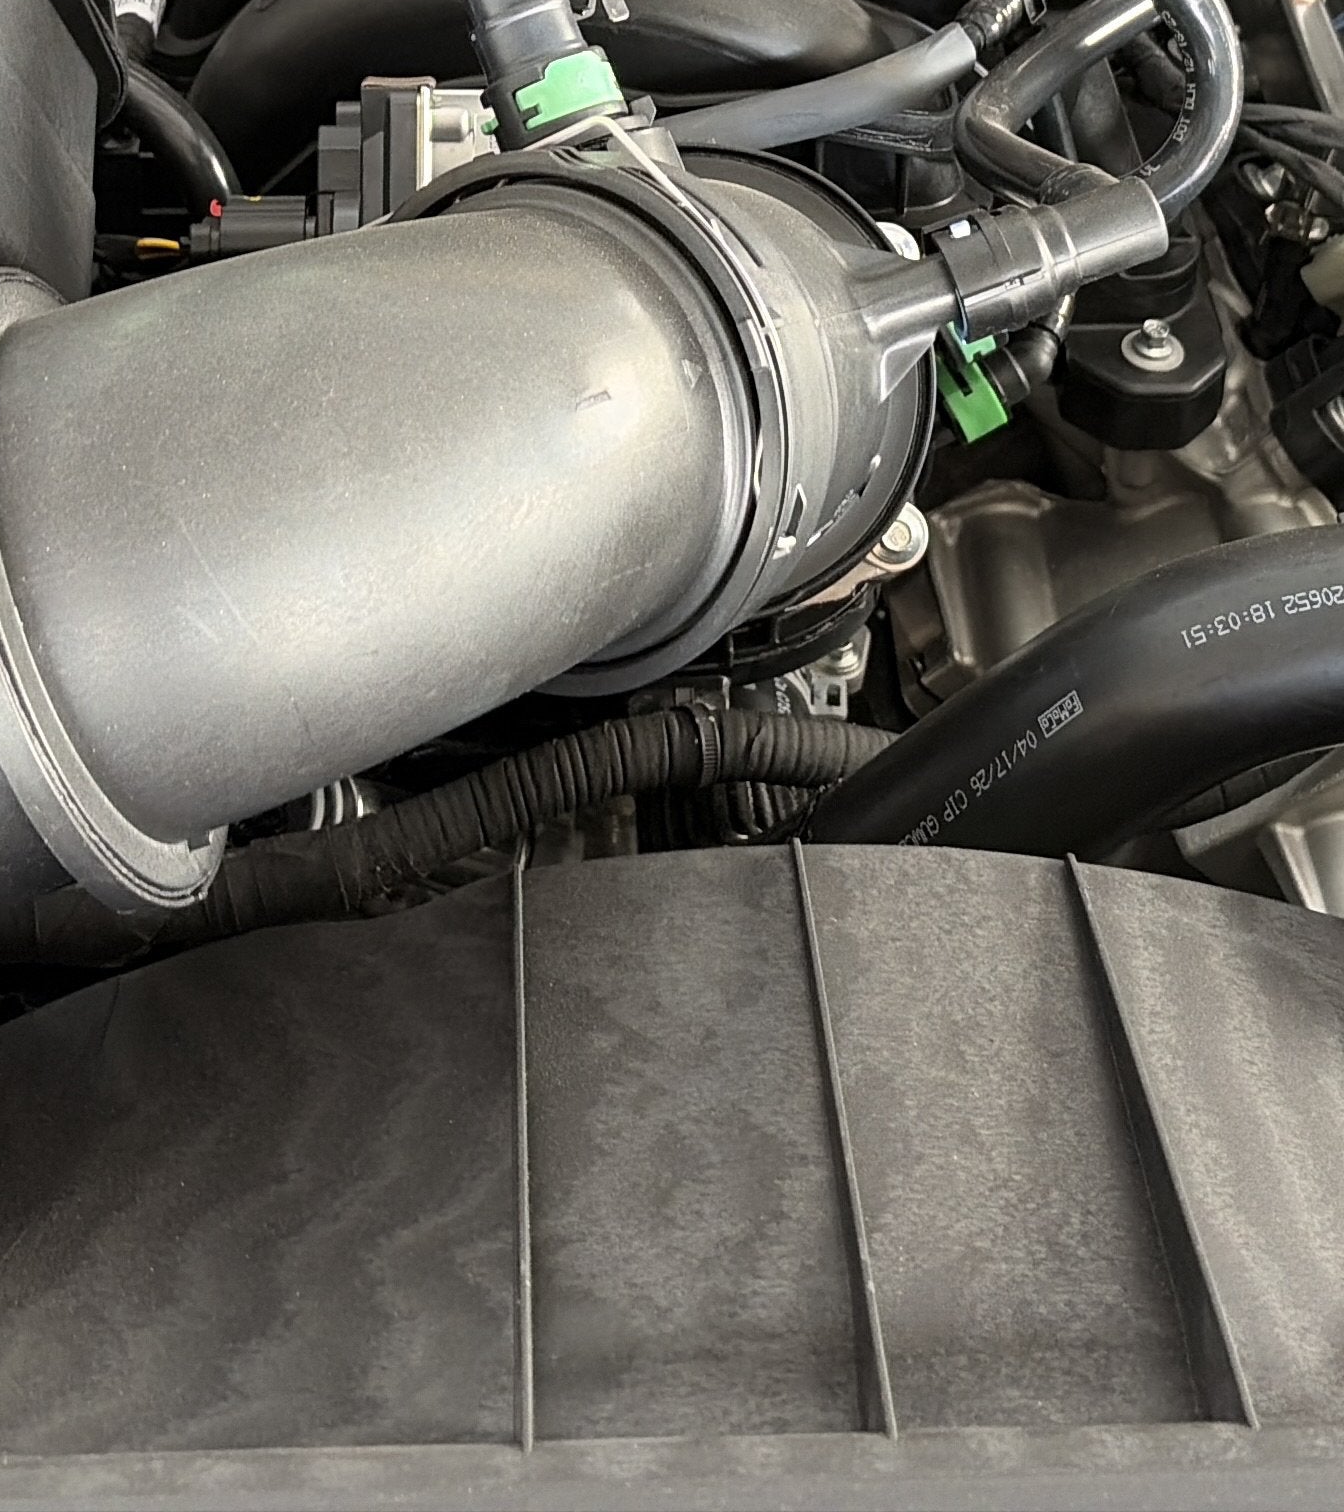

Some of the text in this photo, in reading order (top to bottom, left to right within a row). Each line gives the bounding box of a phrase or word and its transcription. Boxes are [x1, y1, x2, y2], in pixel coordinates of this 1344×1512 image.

[1173, 118, 1191, 143] DOT
[1184, 83, 1196, 110] DLH
[1180, 600, 1276, 649] 18:03:51
[1039, 693, 1081, 733] FoMoCo
[969, 730, 1038, 796] 04/17/26
[942, 788, 968, 822] CIP
